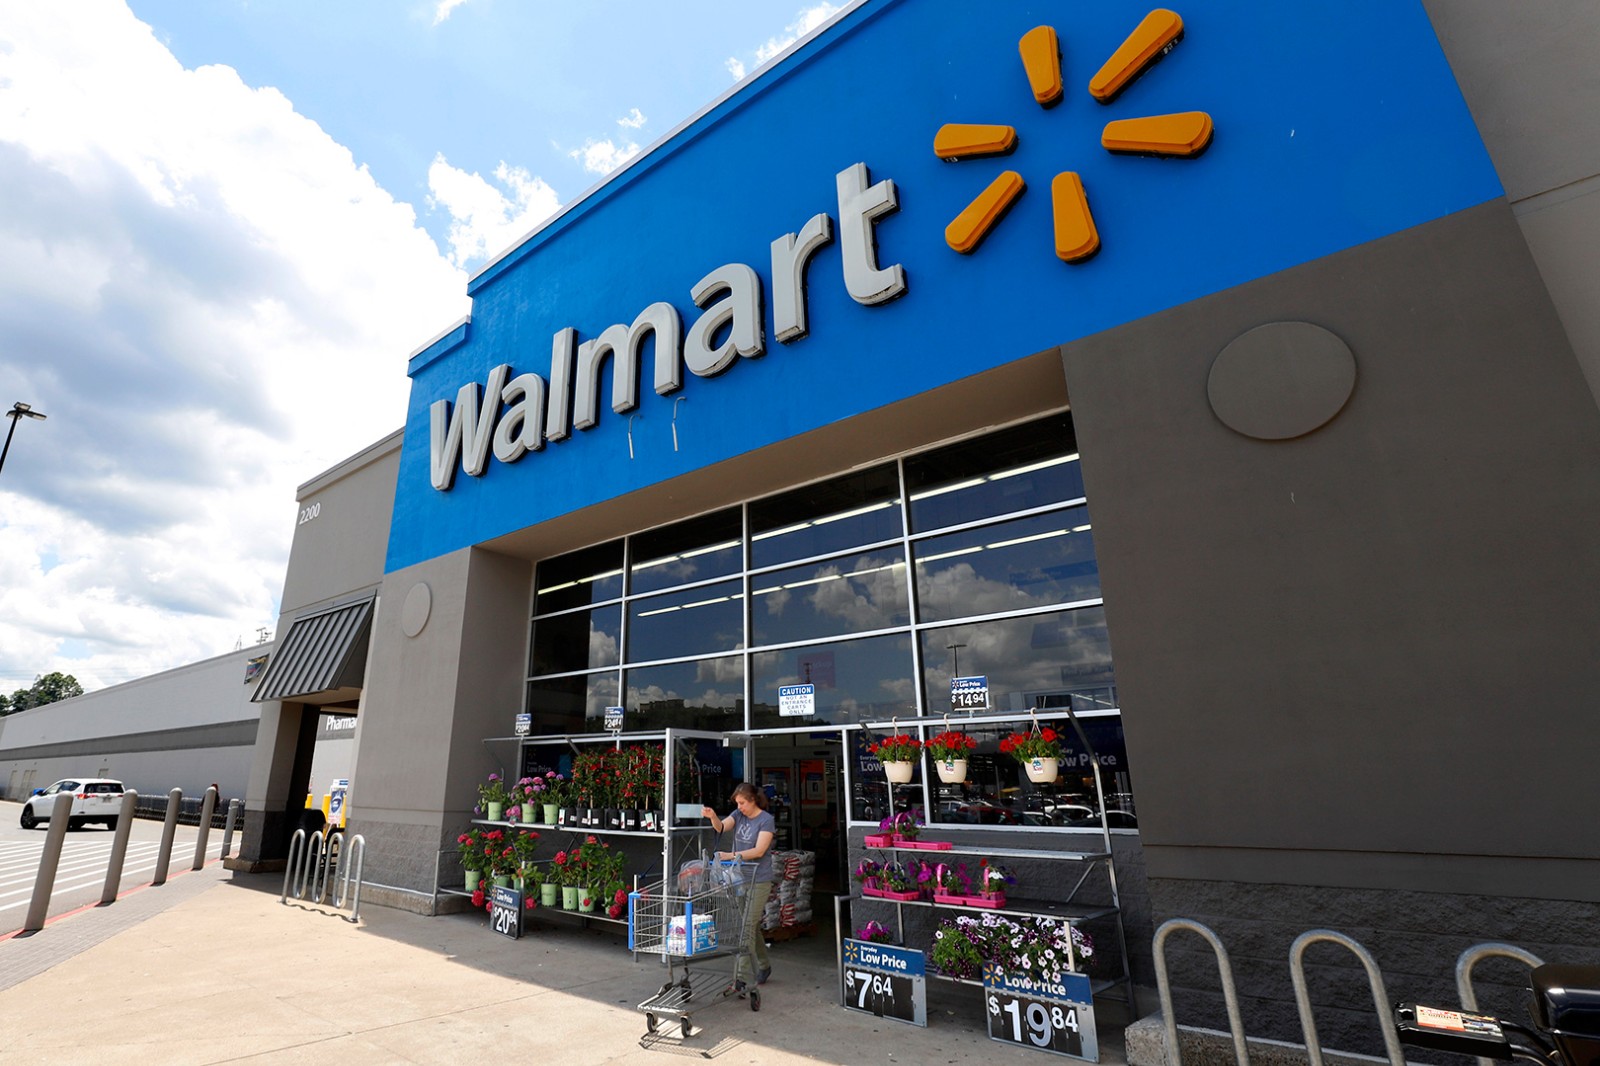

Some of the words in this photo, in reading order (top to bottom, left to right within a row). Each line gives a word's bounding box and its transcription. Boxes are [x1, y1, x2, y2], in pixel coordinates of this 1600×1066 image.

[429, 161, 908, 491] Walmart
[299, 502, 321, 525] 2200
[782, 686, 812, 696] CAUTION
[702, 763, 722, 774] Price
[860, 761, 884, 772] Low
[860, 945, 878, 954] Everyday
[860, 951, 880, 965] Low
[881, 954, 907, 970] Price
